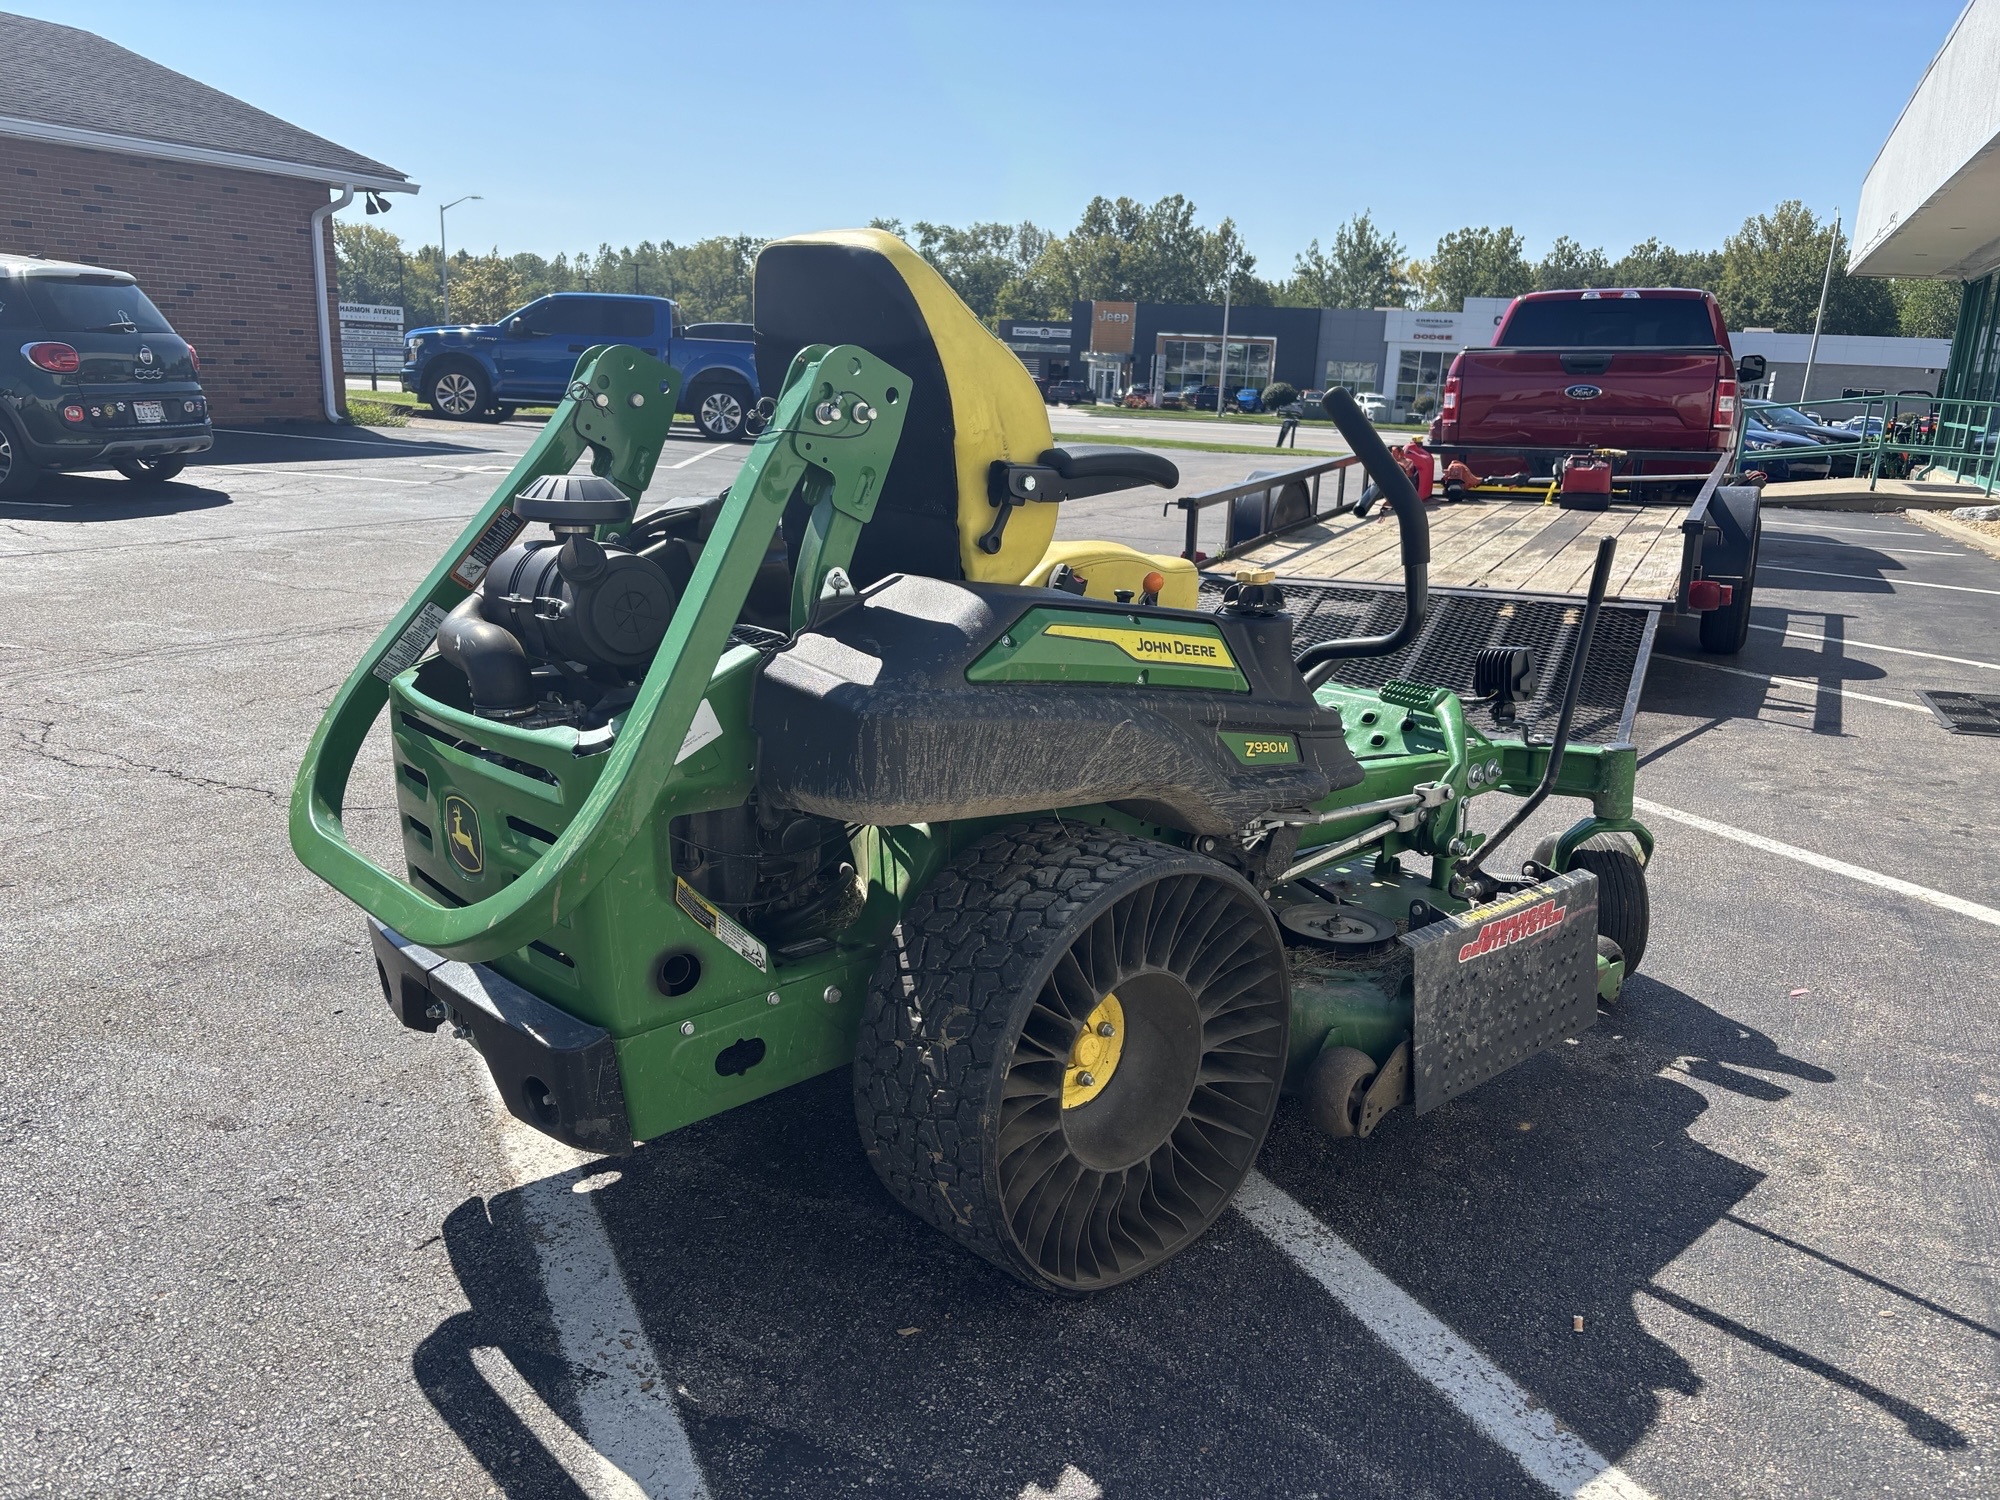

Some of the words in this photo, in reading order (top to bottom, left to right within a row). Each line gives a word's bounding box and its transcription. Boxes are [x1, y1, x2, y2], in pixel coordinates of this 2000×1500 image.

[340, 305, 371, 314] HARMON
[373, 308, 401, 316] AVENUE
[1099, 310, 1129, 324] Jeep
[1573, 388, 1593, 396] Ford
[1137, 637, 1172, 654] JOHN
[1174, 641, 1217, 658] DEERE
[1245, 742, 1289, 757] Z930M
[1459, 930, 1510, 962] CHUTE
[1509, 905, 1566, 944] SYSTEM
